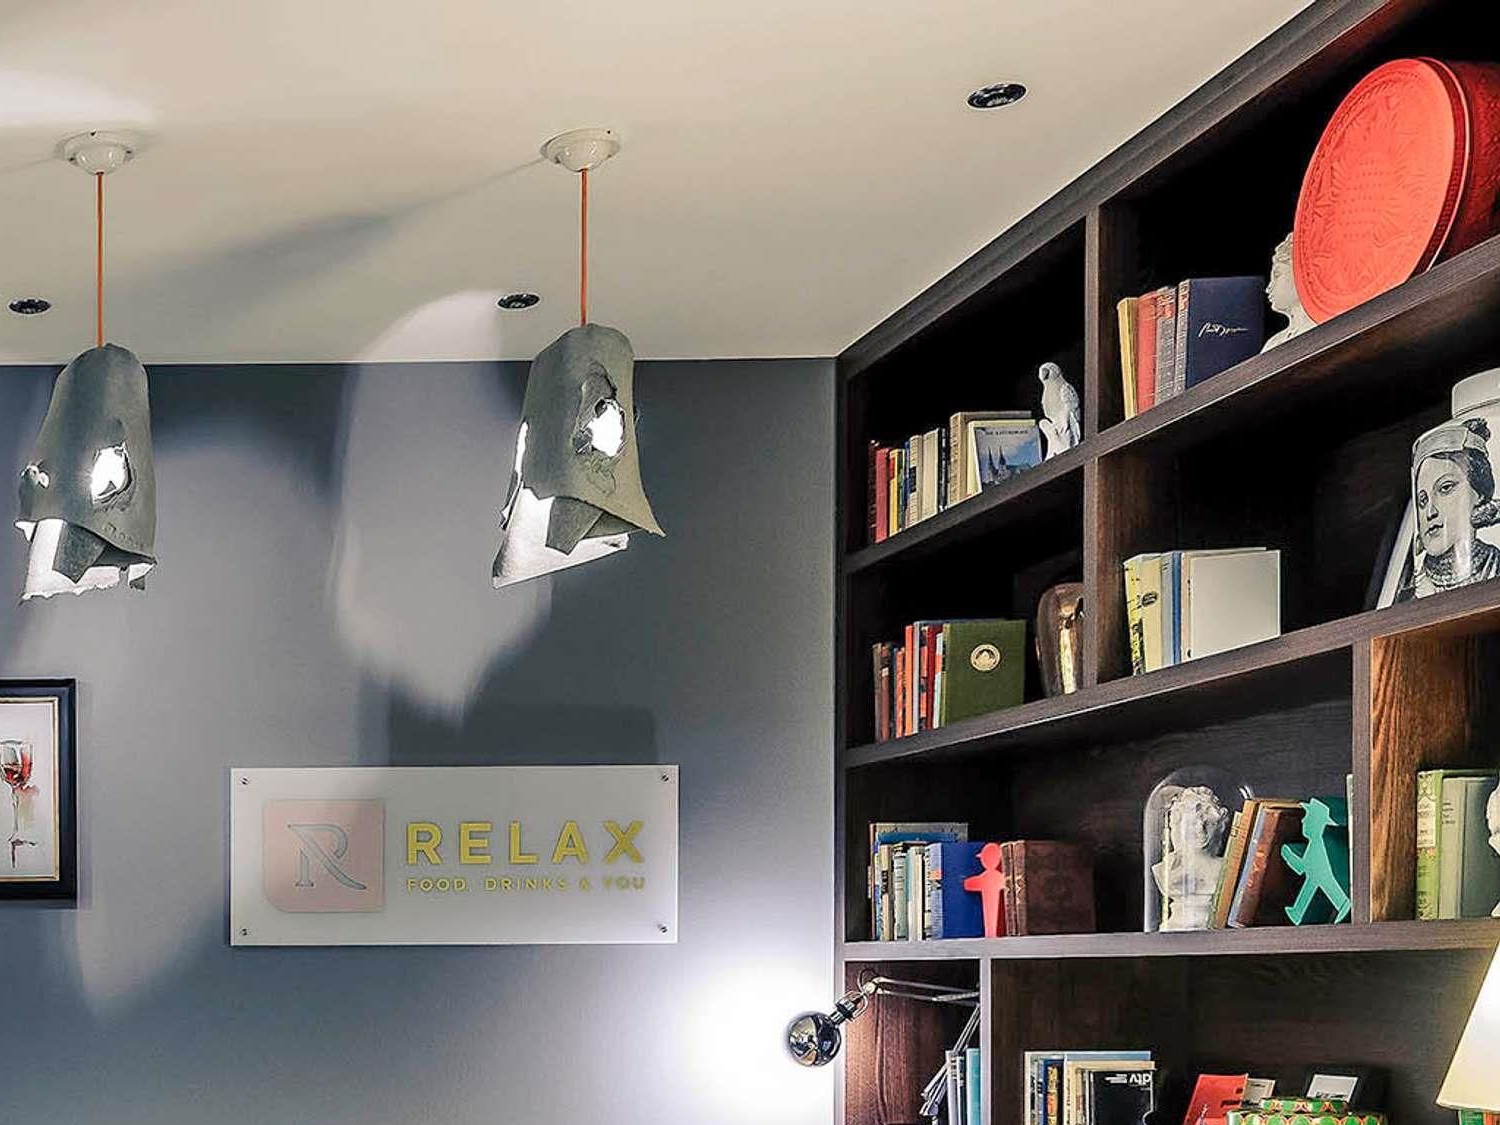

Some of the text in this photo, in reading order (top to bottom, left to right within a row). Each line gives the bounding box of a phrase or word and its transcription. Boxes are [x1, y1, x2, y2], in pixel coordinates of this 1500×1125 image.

[286, 821, 369, 891] R
[405, 819, 645, 866] RELAX
[405, 877, 472, 894] FOOD,
[483, 876, 568, 892] DRINKS
[603, 875, 646, 891] YOU
